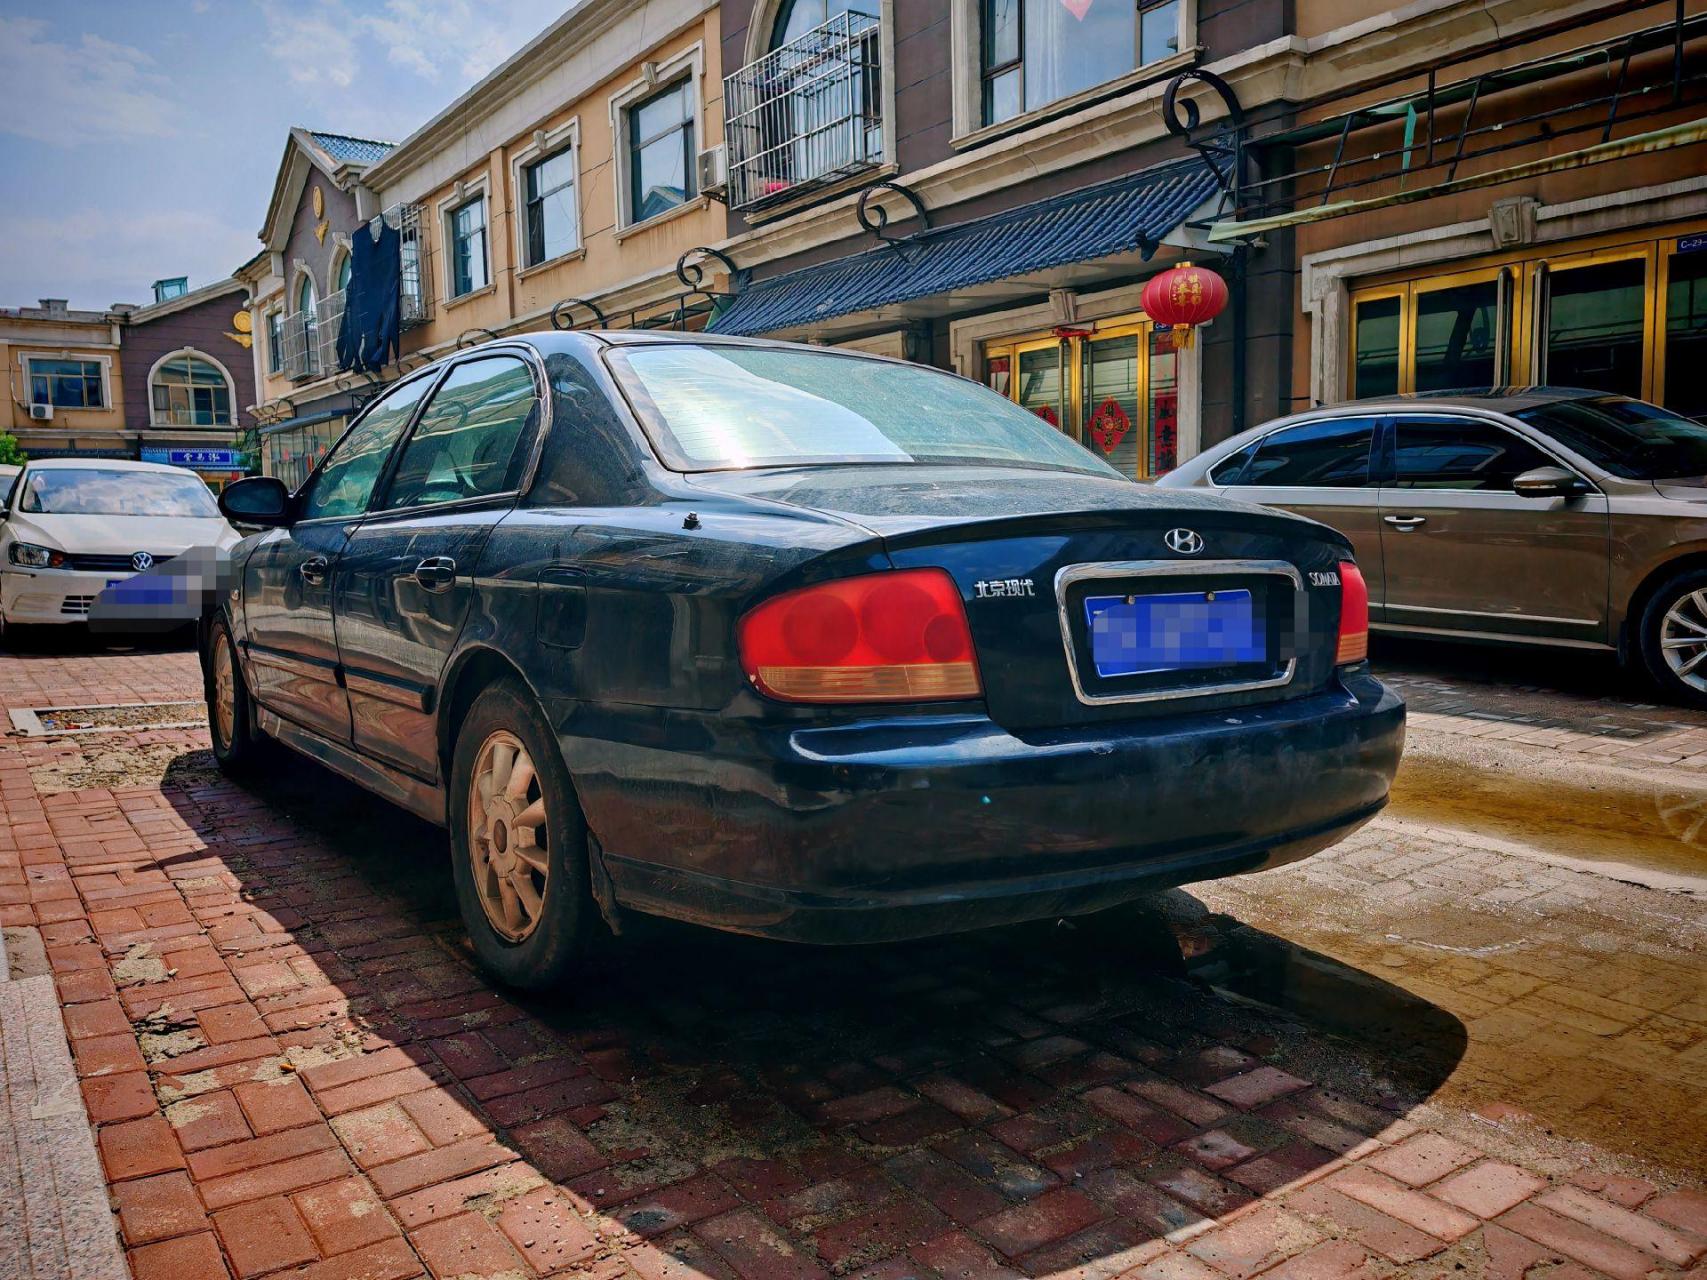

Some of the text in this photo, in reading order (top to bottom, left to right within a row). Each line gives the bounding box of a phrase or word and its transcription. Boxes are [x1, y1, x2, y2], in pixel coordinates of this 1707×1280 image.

[1309, 571, 1341, 586] SONATA
[974, 579, 1036, 598] 北京现代
